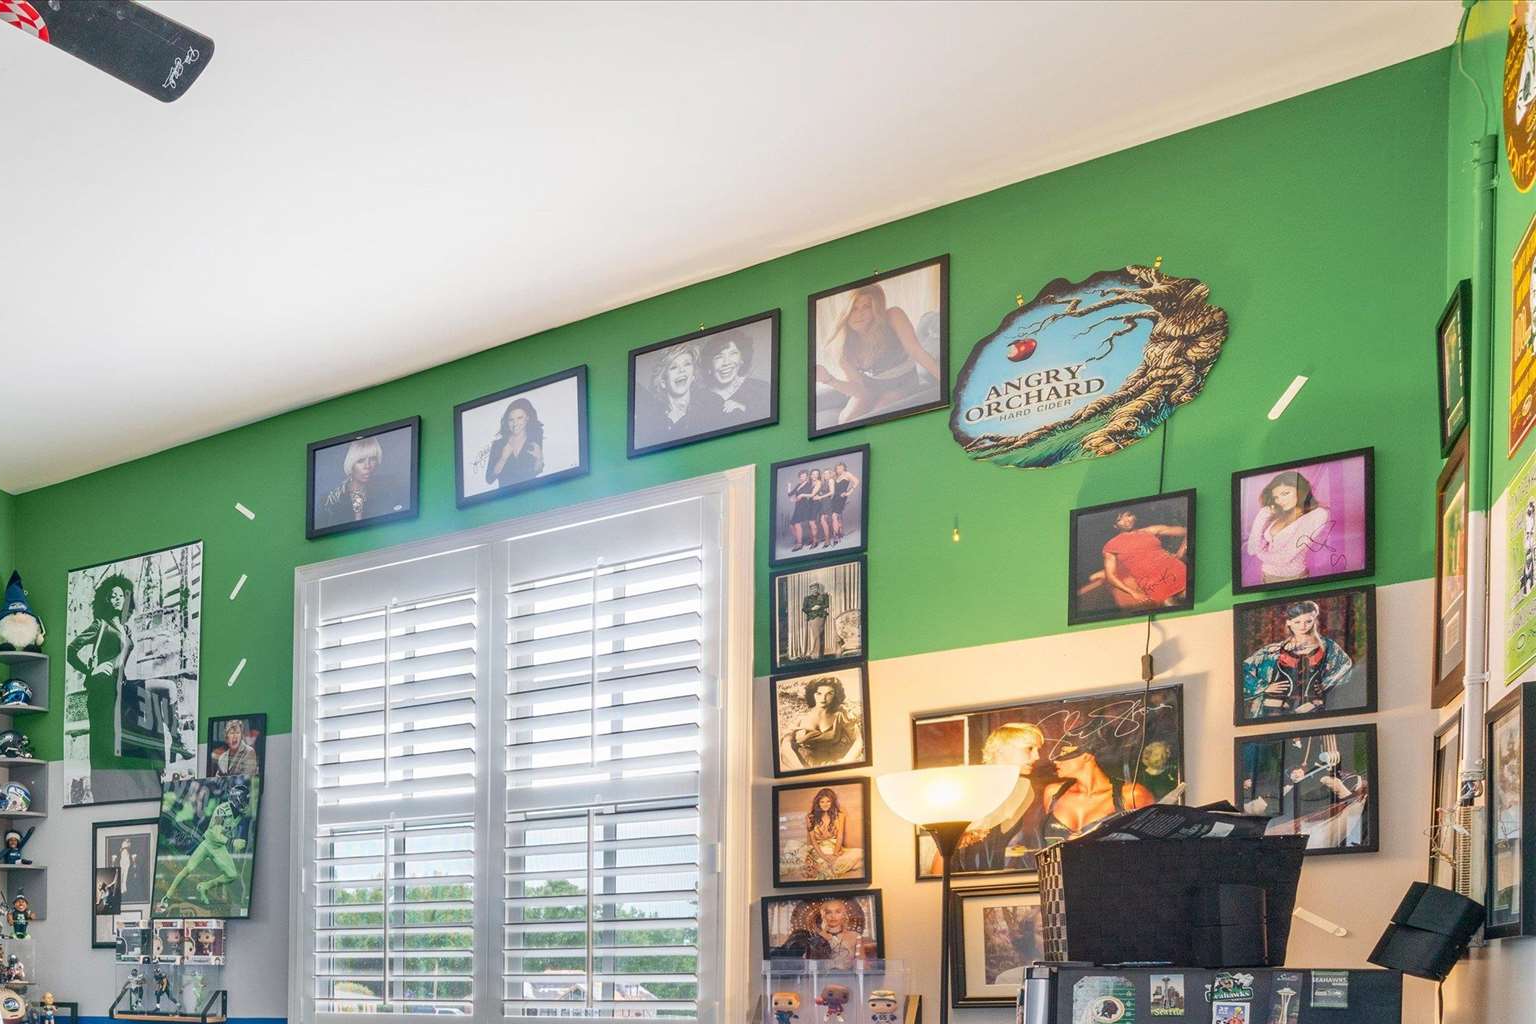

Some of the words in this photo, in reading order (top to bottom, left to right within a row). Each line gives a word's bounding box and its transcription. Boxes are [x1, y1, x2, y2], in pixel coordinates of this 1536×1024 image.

[965, 378, 1105, 423] ORCHARD
[985, 364, 1083, 402] ANGRY
[999, 408, 1032, 422] HARD
[1036, 399, 1072, 414] CIDER
